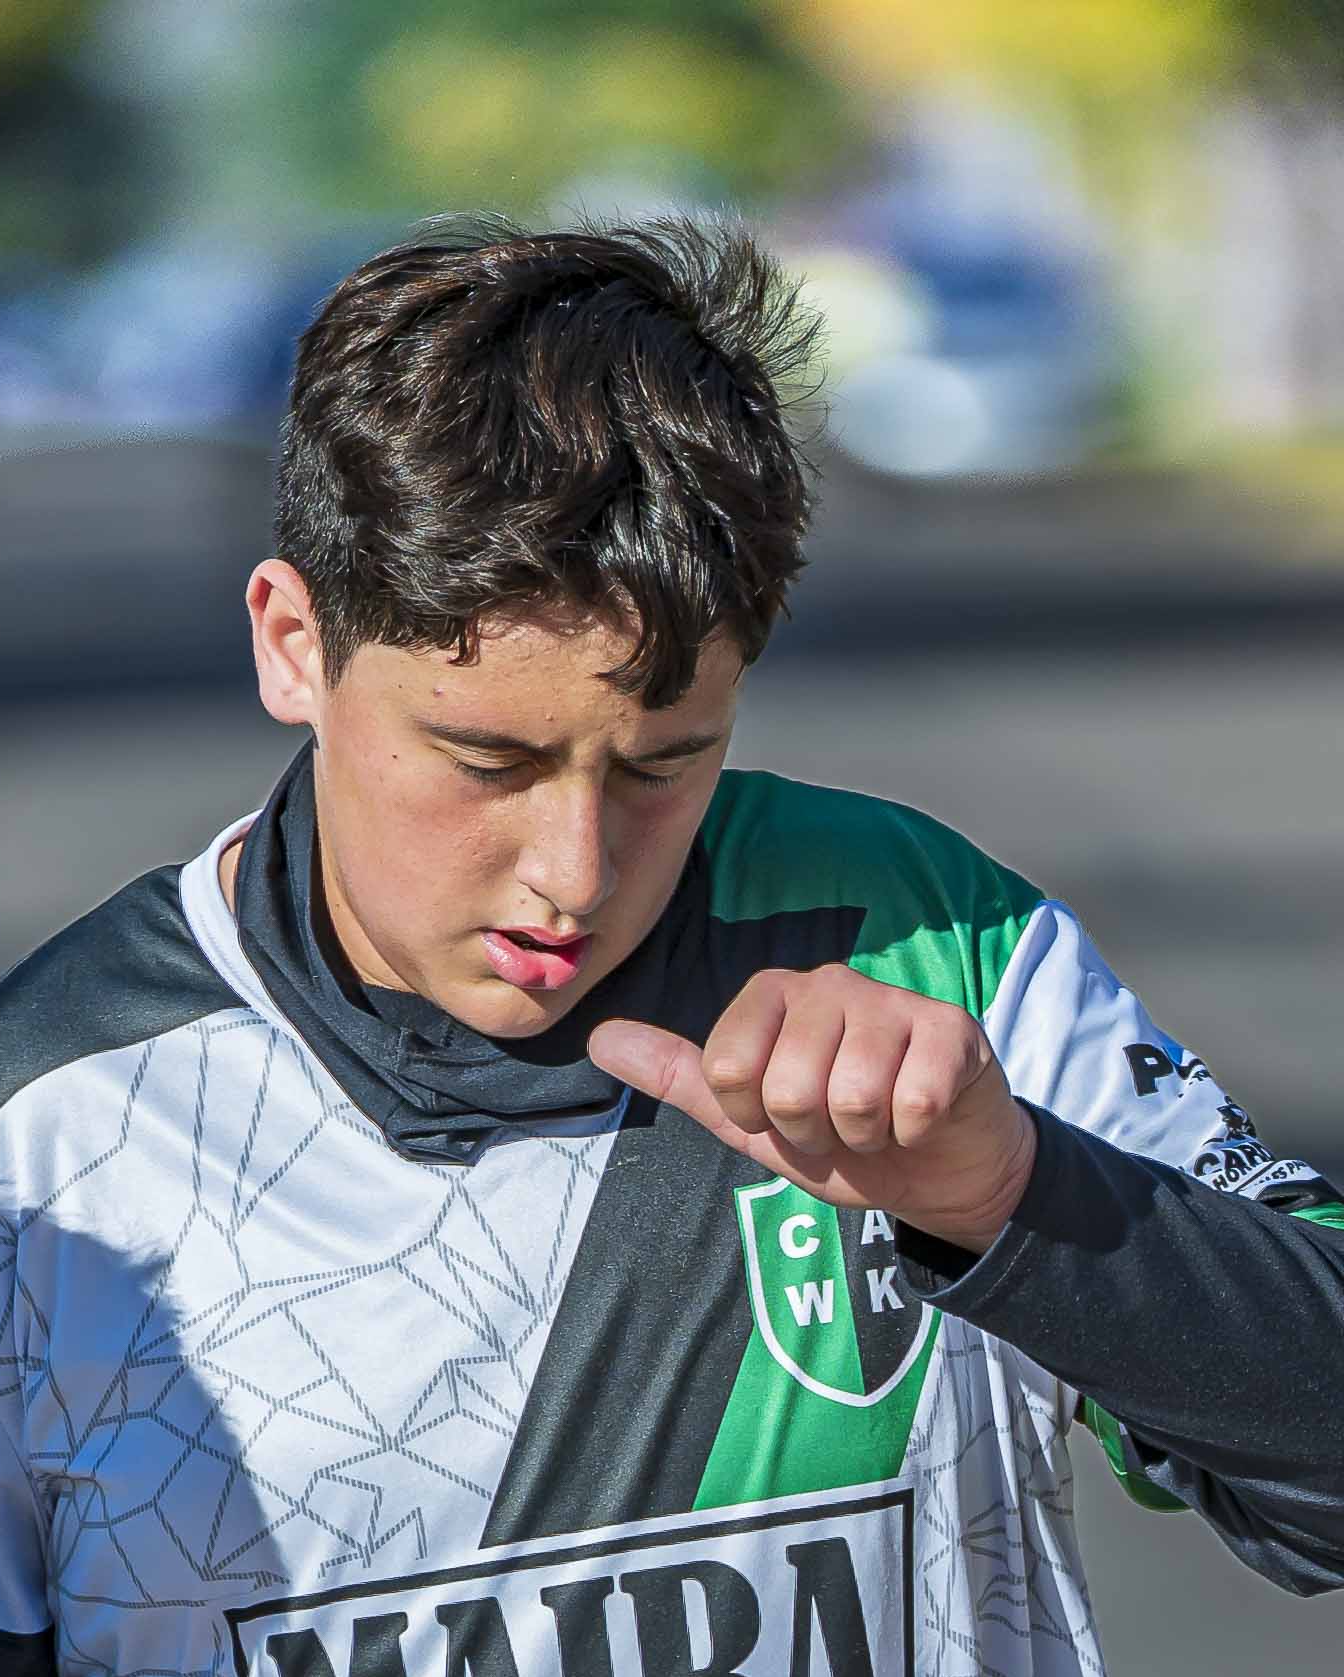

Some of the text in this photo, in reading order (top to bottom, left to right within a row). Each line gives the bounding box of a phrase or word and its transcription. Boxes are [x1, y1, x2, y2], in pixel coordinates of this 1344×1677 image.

[778, 1209, 894, 1259] C A
[785, 1266, 905, 1327] W K
